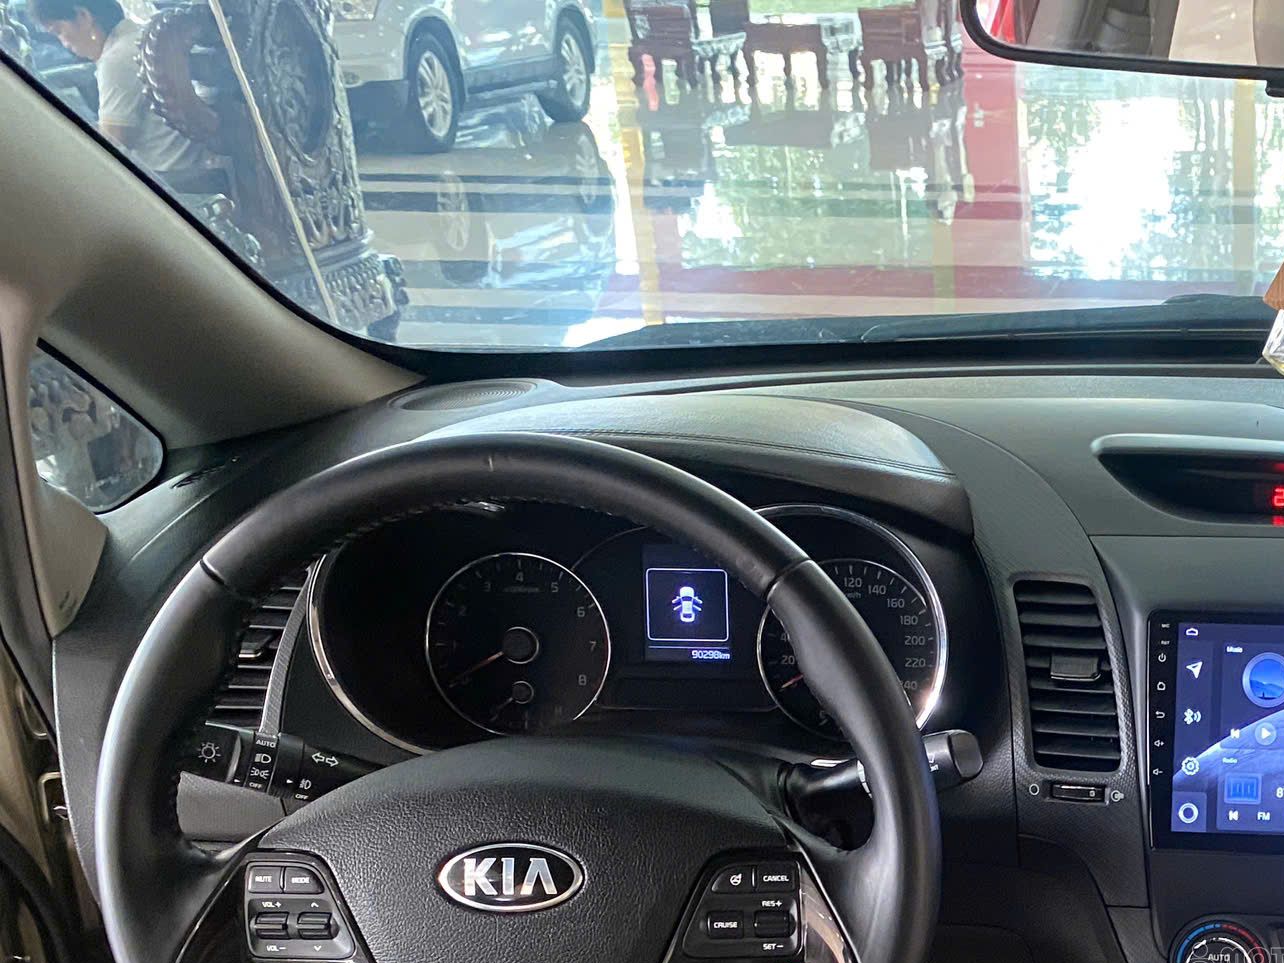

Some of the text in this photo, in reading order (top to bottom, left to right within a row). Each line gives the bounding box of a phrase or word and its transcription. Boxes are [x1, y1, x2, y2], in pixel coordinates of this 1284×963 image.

[844, 577, 862, 588] 120
[868, 585, 887, 595] 140
[904, 636, 925, 646] 200
[905, 658, 926, 668] 220
[255, 739, 277, 749] AUTO
[1257, 811, 1270, 821] FM
[463, 857, 558, 897] KIA
[762, 874, 789, 882] CANCEL
[1207, 953, 1231, 962] AUTO
